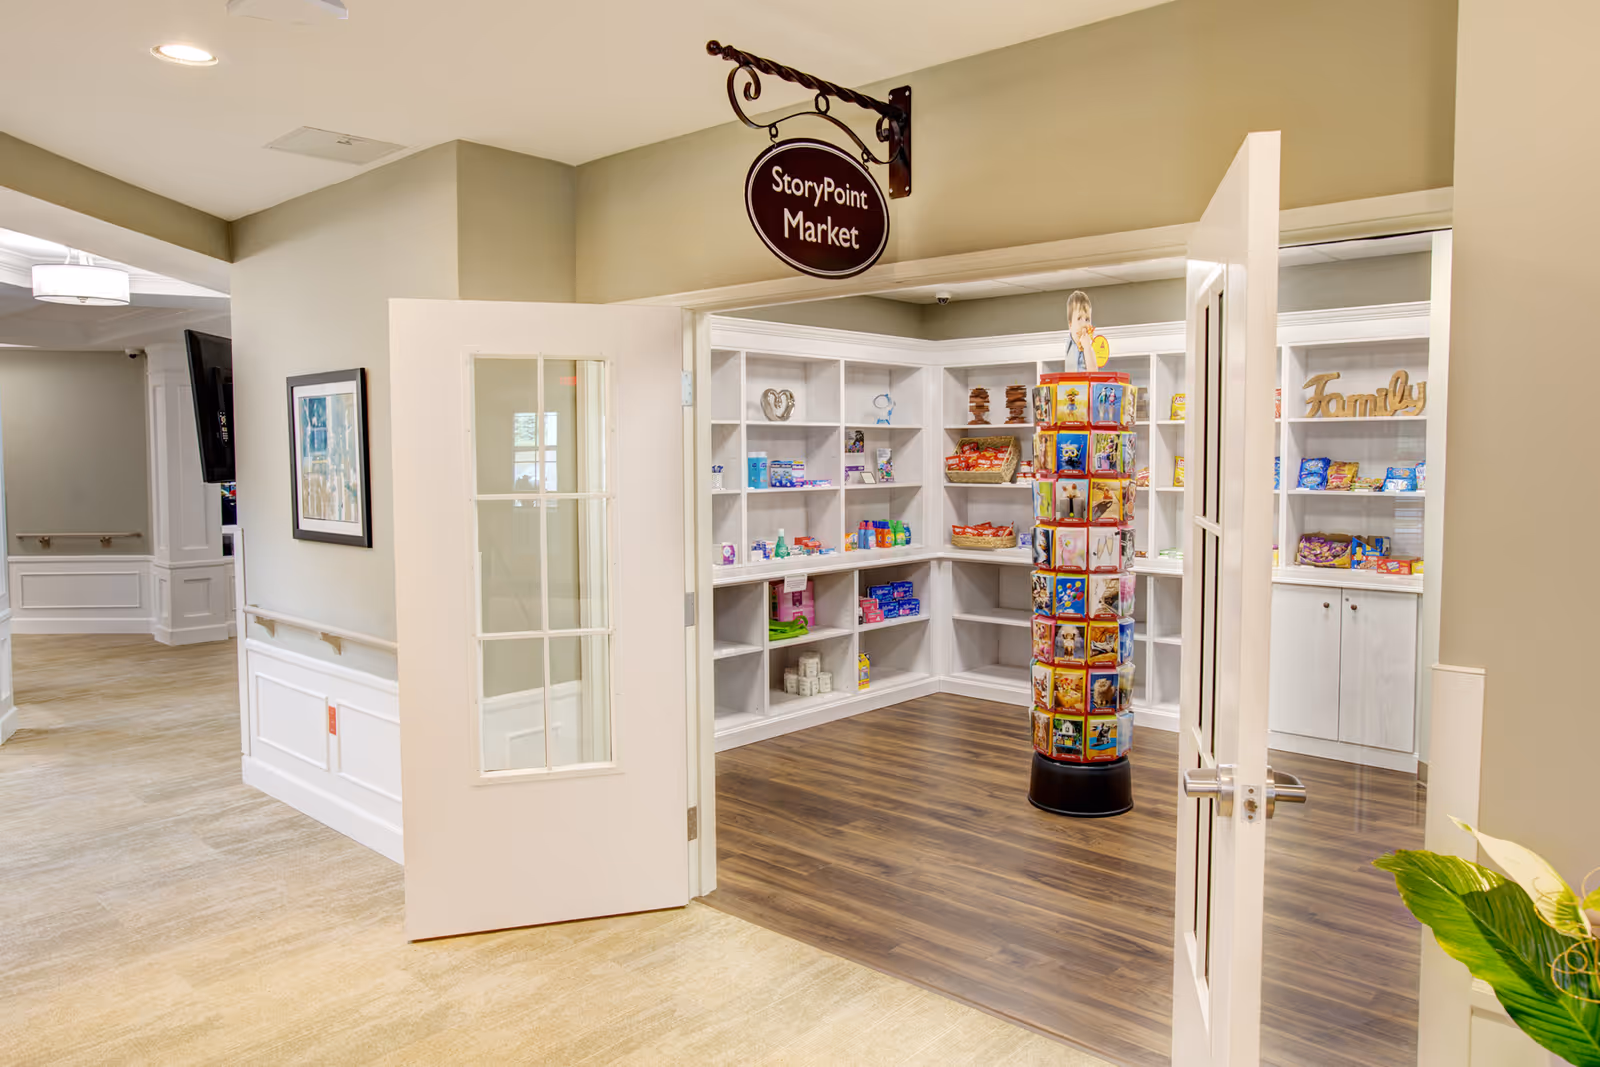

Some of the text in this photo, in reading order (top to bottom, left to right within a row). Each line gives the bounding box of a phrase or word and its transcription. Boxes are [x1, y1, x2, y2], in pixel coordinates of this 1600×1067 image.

[771, 165, 869, 209] StoryPoint
[783, 207, 860, 250] Market
[1302, 369, 1427, 418] Family
